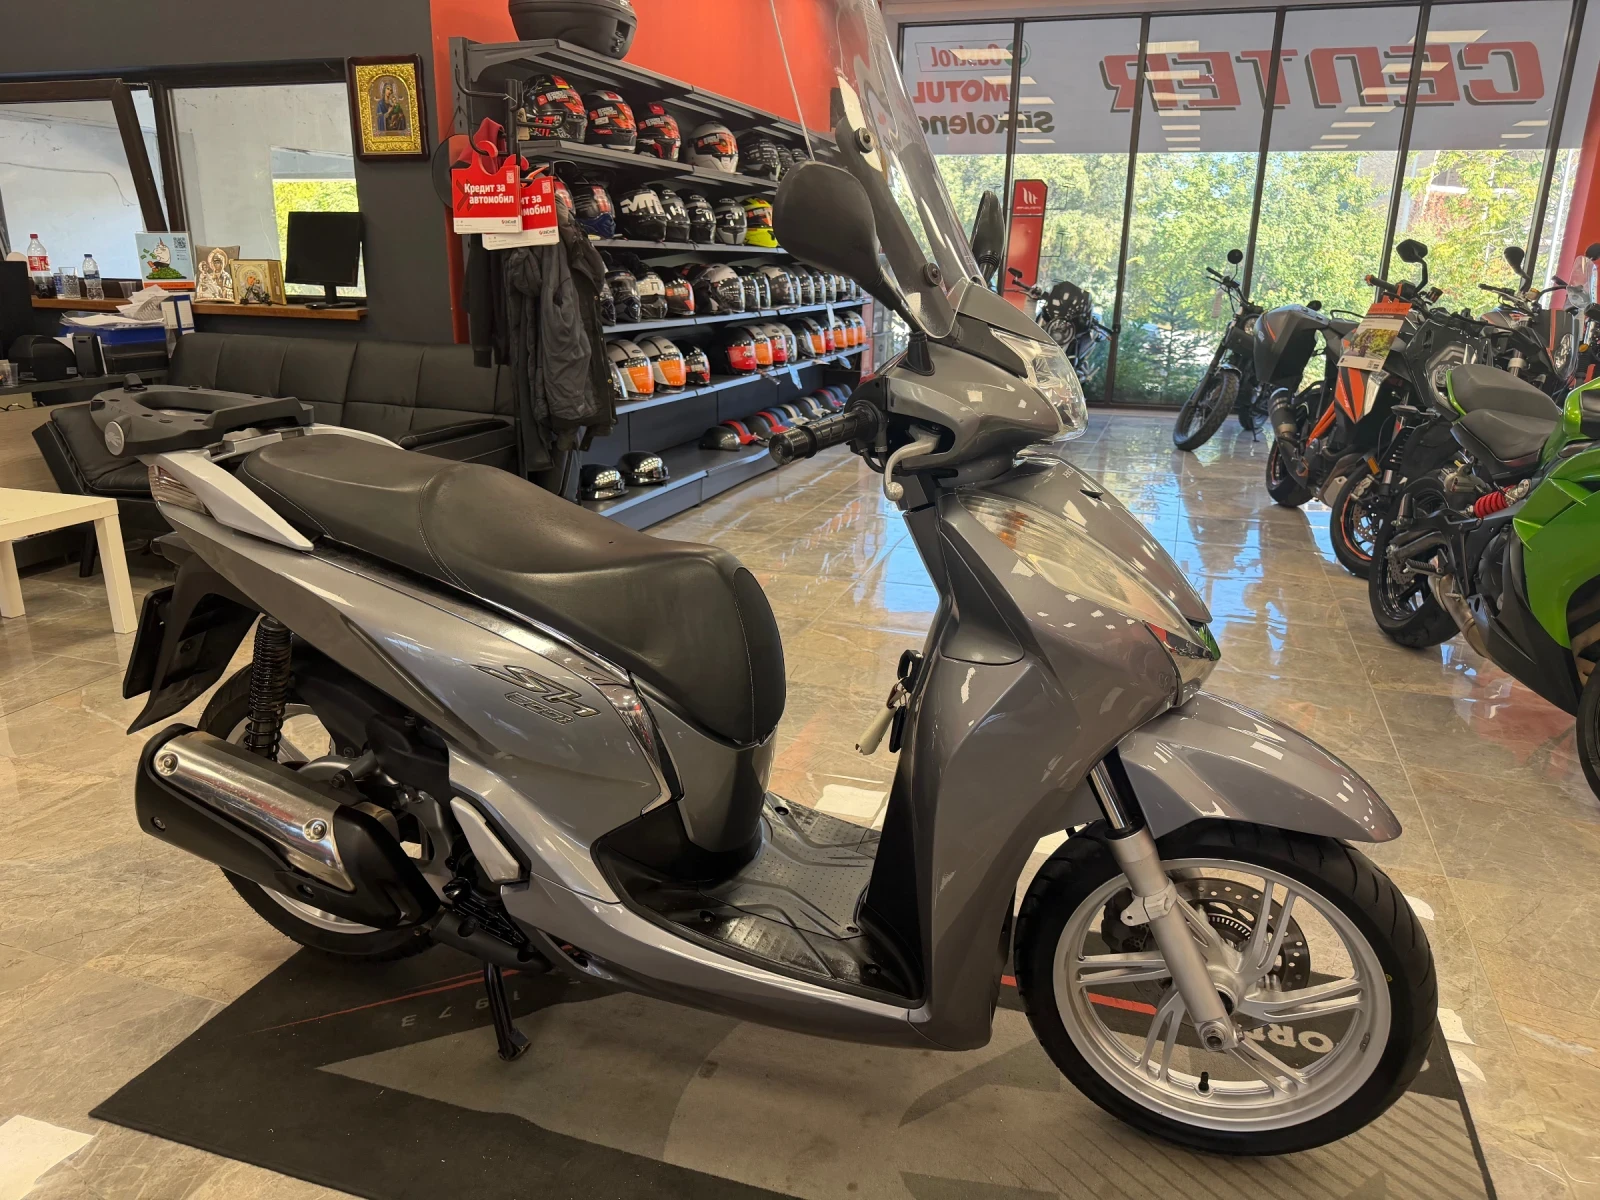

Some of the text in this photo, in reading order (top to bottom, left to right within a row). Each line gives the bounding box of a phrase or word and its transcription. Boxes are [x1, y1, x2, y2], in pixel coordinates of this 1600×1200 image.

[464, 183, 505, 195] Кредит за
[469, 193, 514, 204] автомобил
[532, 195, 541, 203] за
[520, 204, 552, 216] мобил
